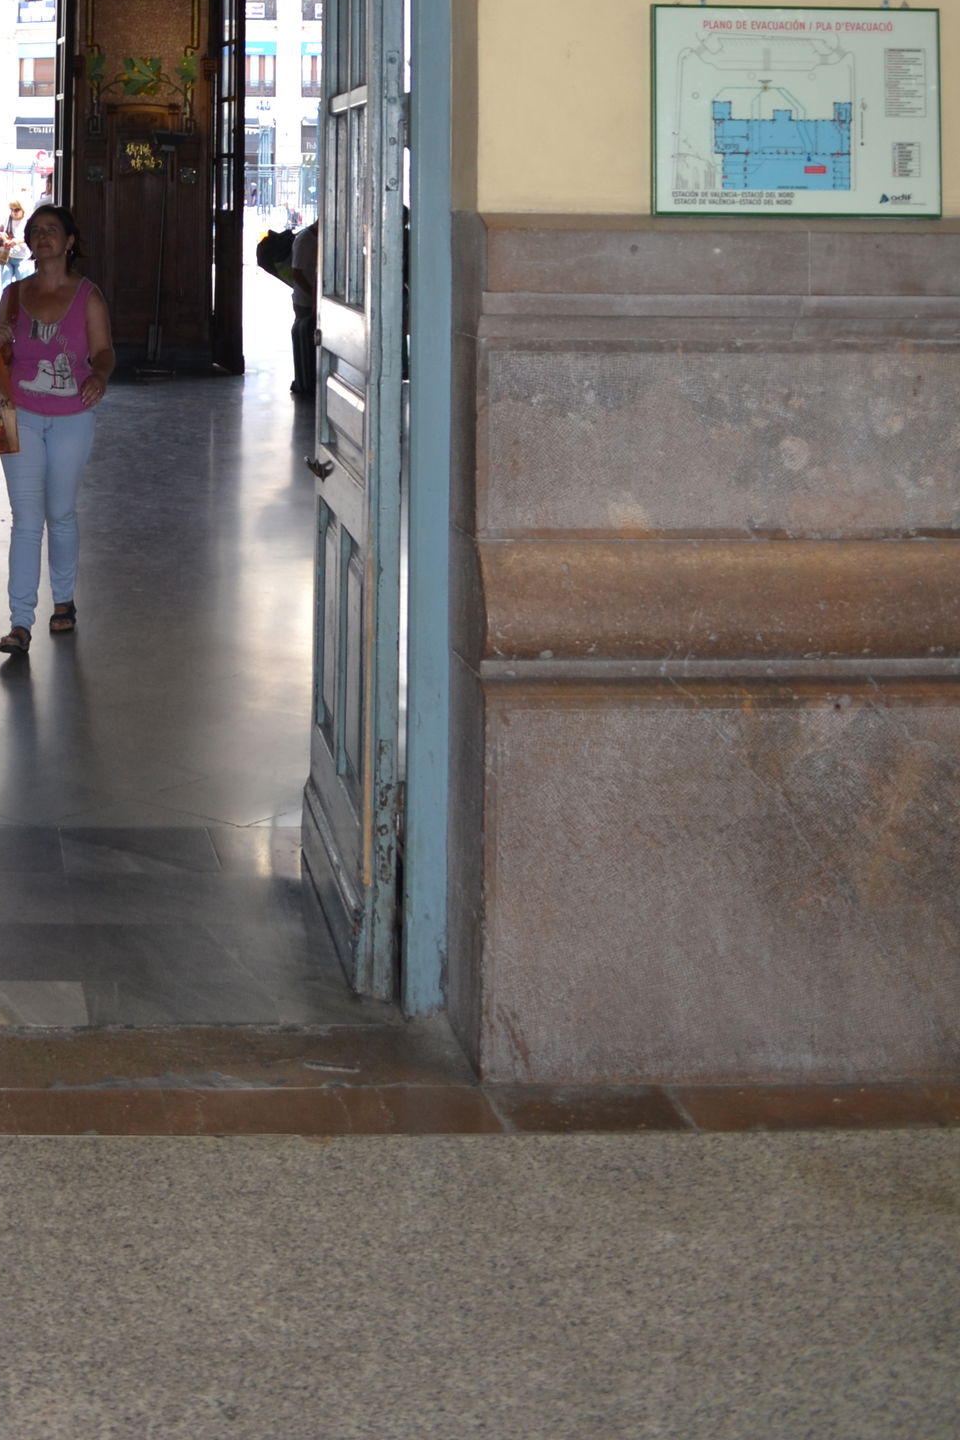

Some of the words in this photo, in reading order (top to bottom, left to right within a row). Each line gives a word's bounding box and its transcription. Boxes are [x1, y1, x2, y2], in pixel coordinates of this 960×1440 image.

[703, 19, 733, 30] PLANO
[736, 20, 748, 30] DE
[751, 19, 806, 31] EVACUACIÓN
[816, 21, 833, 31] PLA
